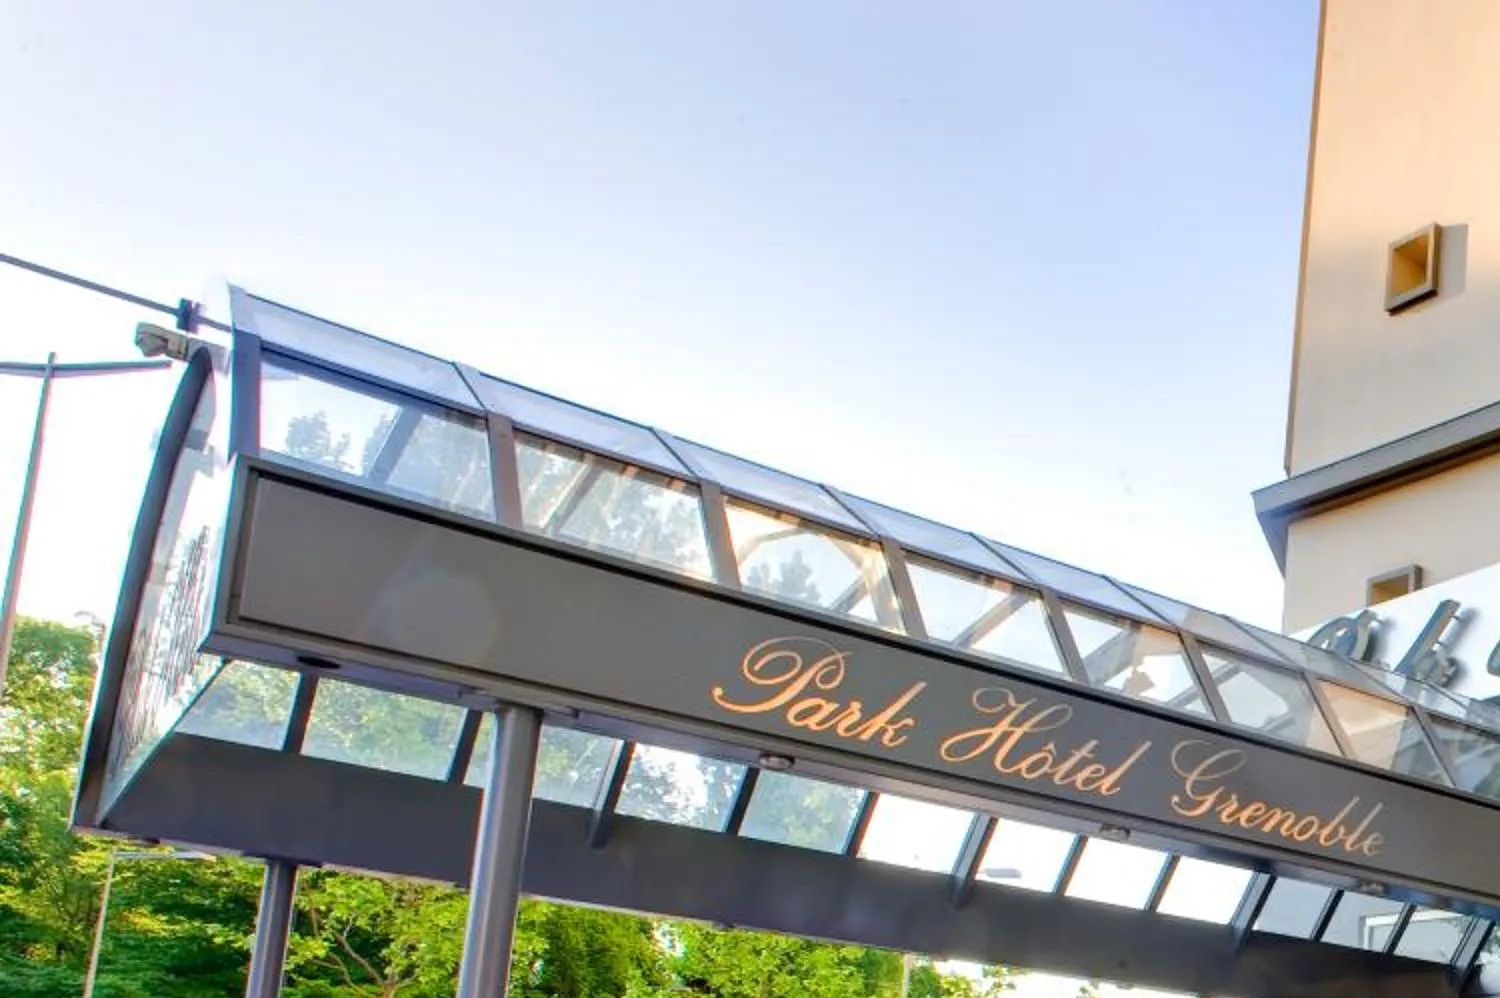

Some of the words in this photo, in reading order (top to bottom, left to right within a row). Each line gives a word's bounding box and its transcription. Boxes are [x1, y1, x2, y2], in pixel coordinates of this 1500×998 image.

[1306, 599, 1463, 688] Pk
[711, 636, 927, 747] Park
[940, 687, 1152, 796] Hôtel
[1170, 738, 1385, 856] Grenoble
